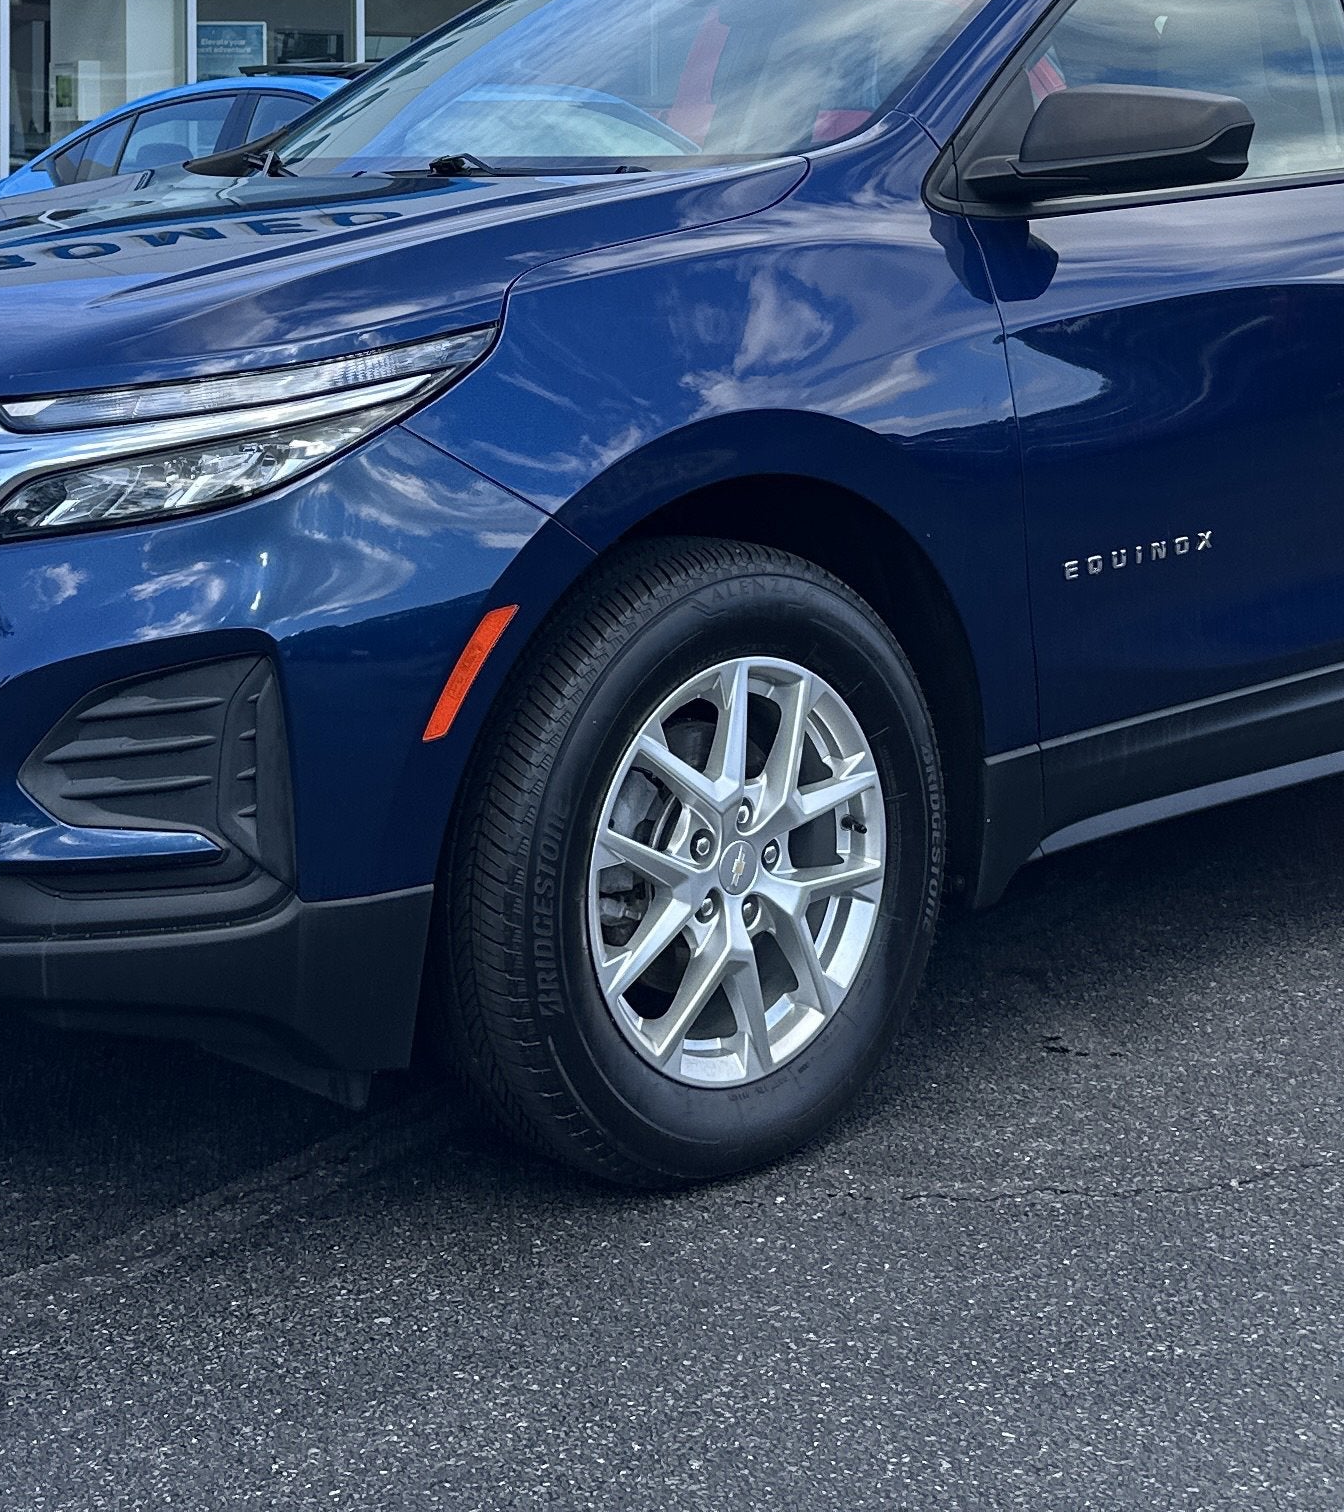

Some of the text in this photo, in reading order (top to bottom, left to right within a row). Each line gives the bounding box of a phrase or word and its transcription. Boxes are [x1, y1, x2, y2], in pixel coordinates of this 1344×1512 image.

[1064, 530, 1213, 581] EQUINOX
[711, 578, 798, 603] ALENZA
[920, 744, 941, 931] BRIDGESTONE
